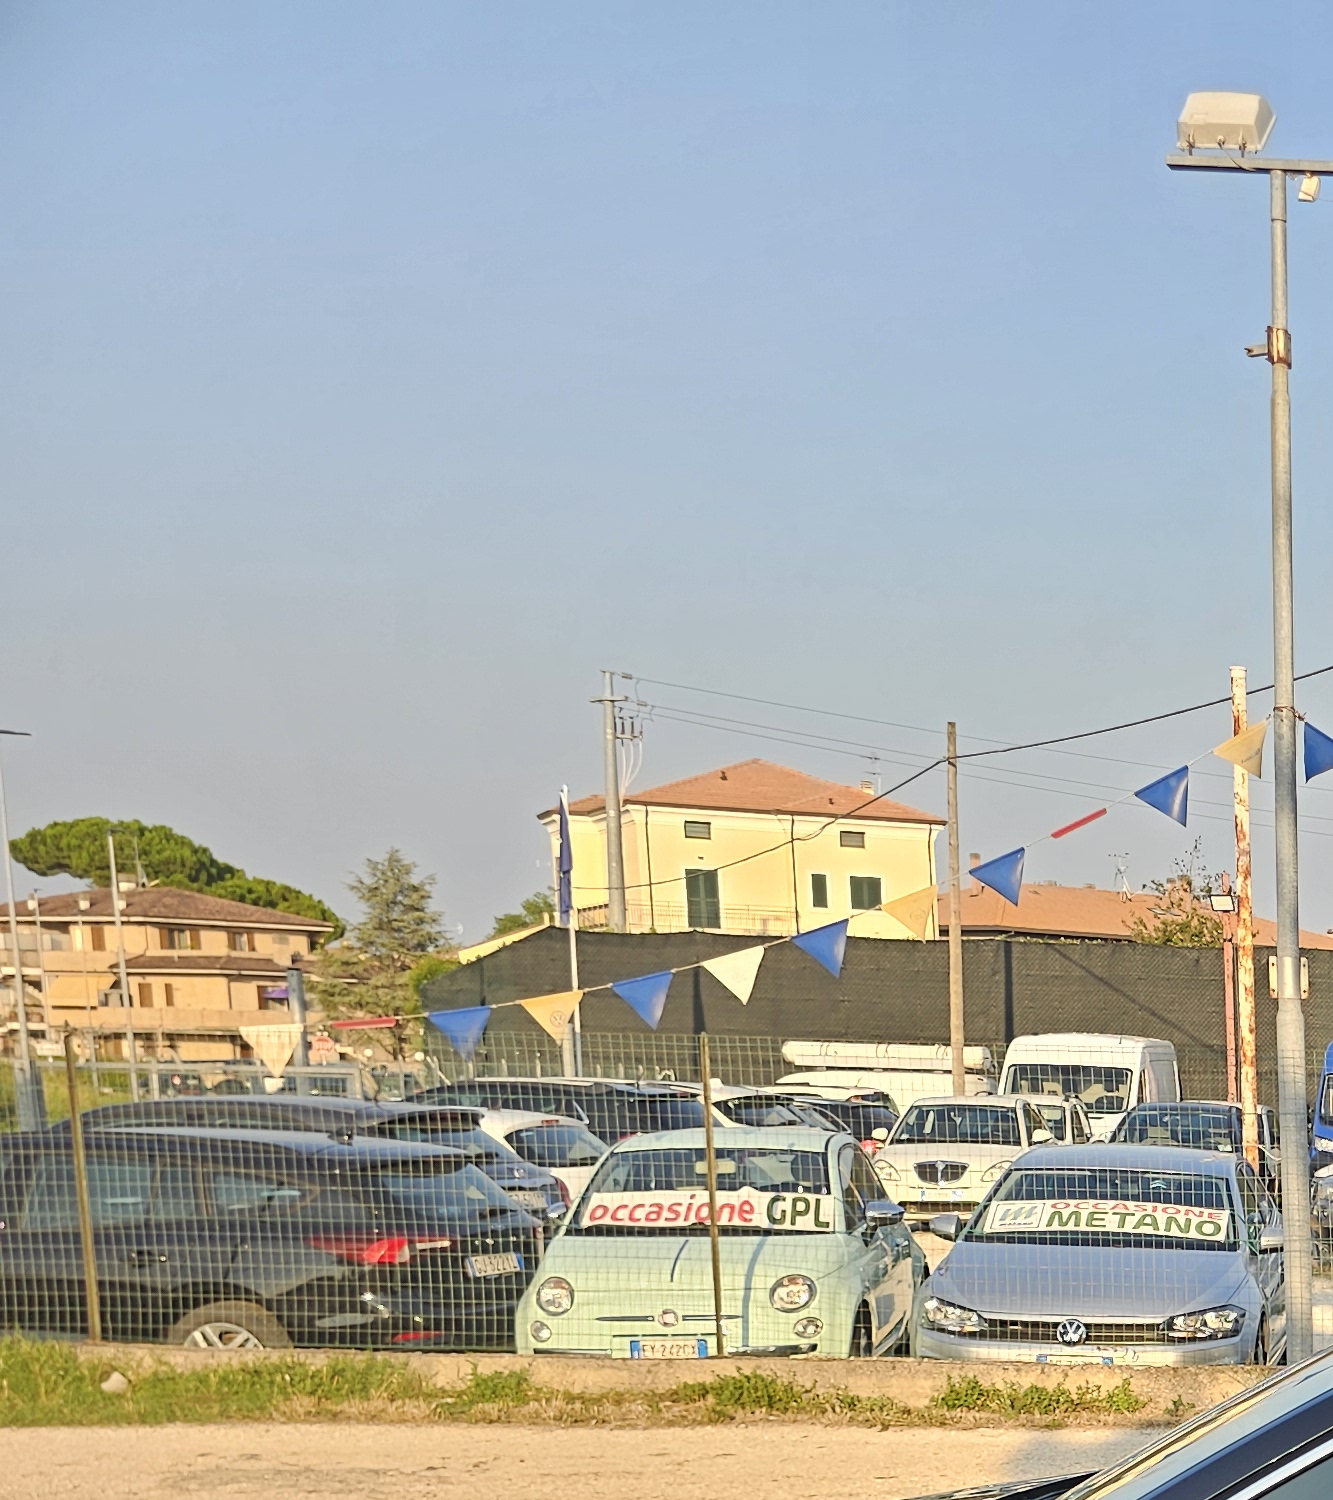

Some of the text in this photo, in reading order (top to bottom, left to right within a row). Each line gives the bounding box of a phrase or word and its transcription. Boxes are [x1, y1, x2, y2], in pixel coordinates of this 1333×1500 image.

[589, 1194, 830, 1228] occasione GPL
[1046, 1210, 1222, 1237] METANO
[1050, 1201, 1224, 1221] OCCASIONE
